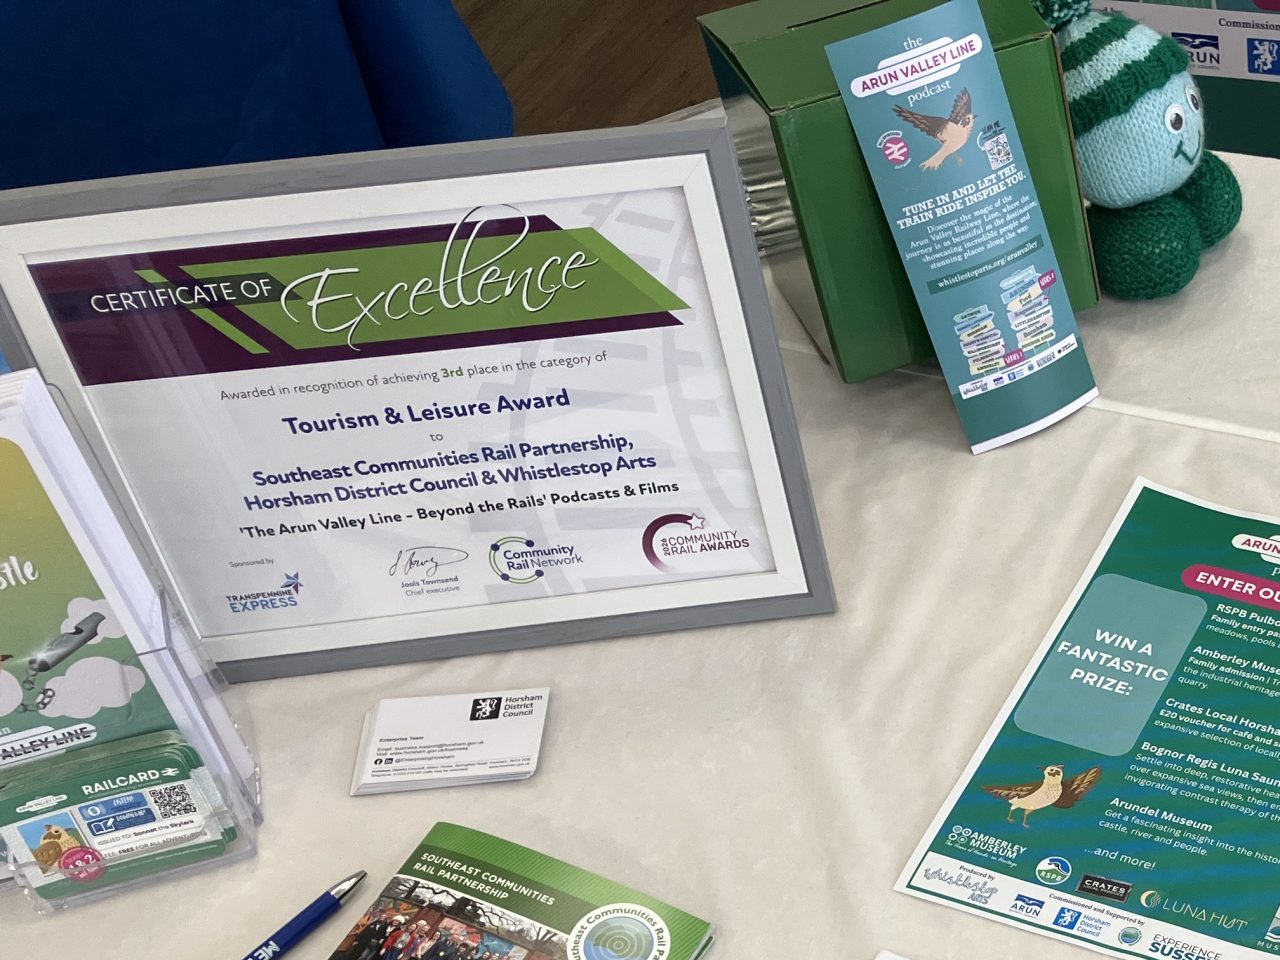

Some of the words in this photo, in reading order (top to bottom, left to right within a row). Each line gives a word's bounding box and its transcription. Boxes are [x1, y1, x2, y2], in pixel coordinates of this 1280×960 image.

[904, 37, 923, 49] the
[862, 70, 899, 92] ARUN
[899, 52, 946, 78] VALLEY
[949, 40, 976, 60] LINE
[907, 80, 951, 106] podcast
[282, 203, 600, 351] Excellence
[938, 241, 1039, 287] whistlestoparts.org/arunvalley
[91, 283, 236, 312] CERTIFICATE
[240, 278, 272, 298] OF
[221, 385, 276, 401] Awarded
[278, 386, 291, 395] in
[293, 379, 364, 393] recognition
[366, 374, 378, 386] of
[382, 371, 440, 385] achieving
[440, 366, 464, 378] 3rd
[467, 365, 499, 379] place
[501, 362, 513, 372] in
[516, 359, 537, 371] the
[540, 356, 591, 369] category
[595, 350, 607, 362] of
[281, 412, 379, 435] Tourism
[384, 407, 404, 425] &
[406, 402, 491, 422] Leisure
[497, 388, 570, 413] Award
[252, 465, 353, 486] Southeast
[354, 450, 480, 476] Communities
[481, 443, 517, 462] Rail
[518, 435, 634, 458] Partnership,
[243, 491, 333, 511] Horsham
[334, 482, 408, 501] District
[409, 471, 478, 493] Council
[482, 470, 498, 485] &
[497, 462, 613, 483] Whistlestop
[616, 456, 657, 471] Arts
[668, 530, 737, 546] COMMUNITY
[671, 545, 697, 555] RAIL
[700, 538, 750, 552] AWARDS
[503, 545, 574, 562] Community
[506, 559, 530, 571] Rail
[530, 554, 583, 568] Network
[226, 589, 293, 602] TRANSPENNINE
[1196, 572, 1256, 595] ENTER
[229, 596, 298, 613] EXPRESS
[1096, 629, 1138, 651] WIN
[1138, 643, 1152, 656] A
[1057, 642, 1168, 681] FANTASTIC
[1193, 646, 1250, 668] Amberley
[1070, 668, 1133, 695] PRIZE:
[504, 702, 533, 710] District
[505, 695, 542, 703] Horsham
[82, 770, 159, 795] RAILCARD
[413, 862, 435, 874] RAIL
[437, 870, 509, 899] PARTNERSHIP
[421, 853, 481, 876] SOUTHEAST
[481, 872, 555, 905] COMMUNITIES
[1162, 898, 1206, 921] LUNA
[1209, 912, 1248, 931] HUT
